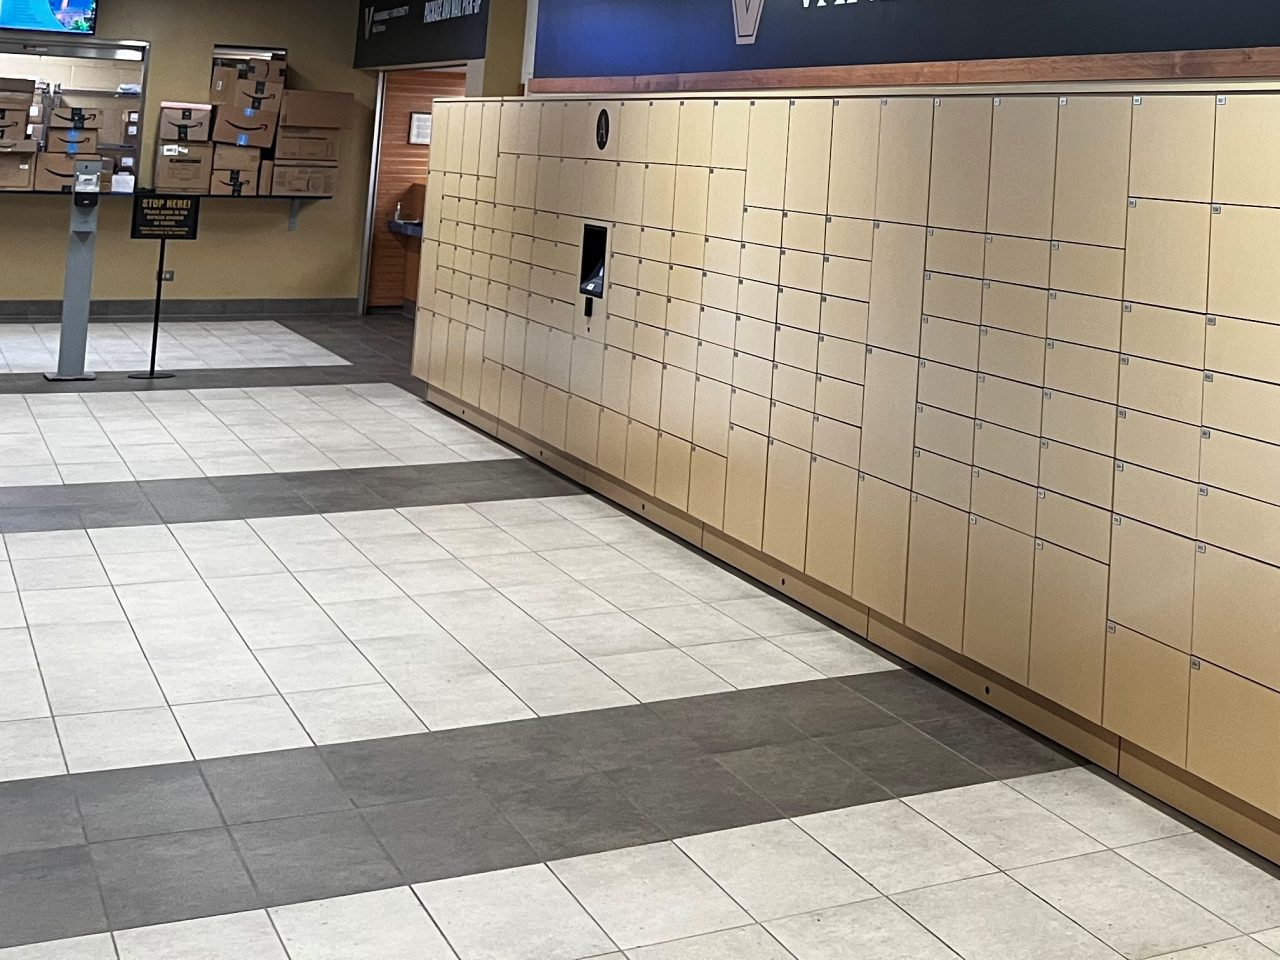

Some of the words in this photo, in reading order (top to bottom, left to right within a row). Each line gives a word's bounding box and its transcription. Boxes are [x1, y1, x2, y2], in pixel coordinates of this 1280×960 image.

[597, 115, 606, 142] A
[142, 198, 165, 208] STOP
[166, 199, 191, 209] HERE!
